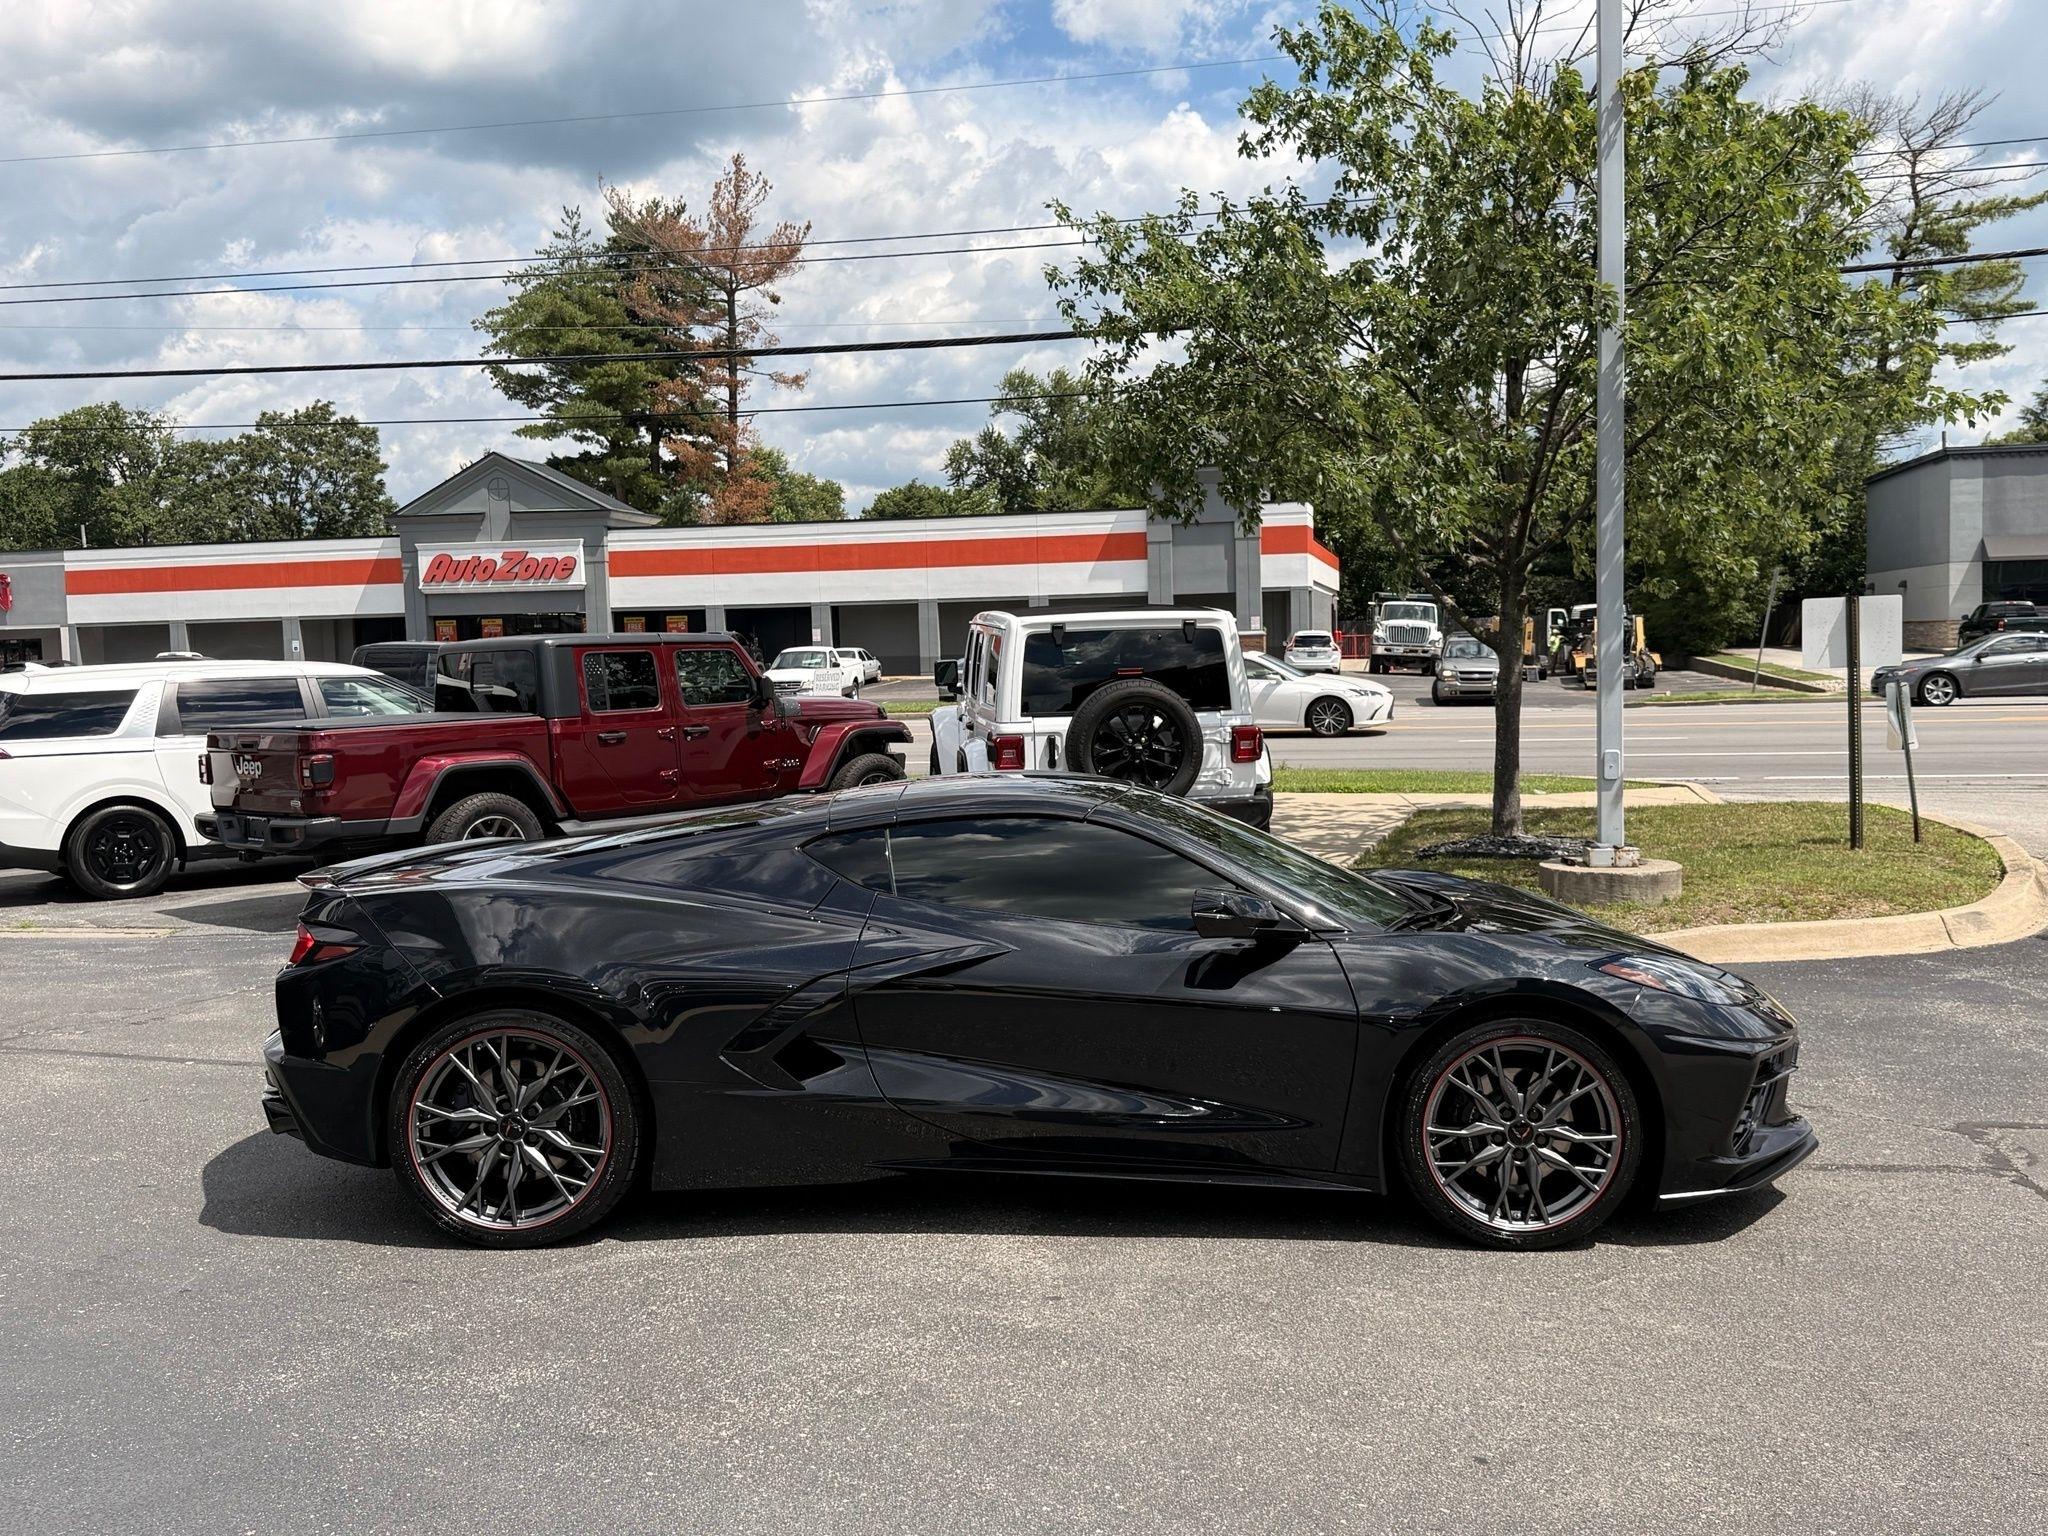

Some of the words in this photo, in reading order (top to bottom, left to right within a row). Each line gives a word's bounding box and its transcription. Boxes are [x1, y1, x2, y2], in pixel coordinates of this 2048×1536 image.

[422, 551, 577, 583] AutoZone
[815, 673, 840, 682] RESERVED
[815, 683, 840, 691] PARKING
[236, 756, 262, 779] Jeep
